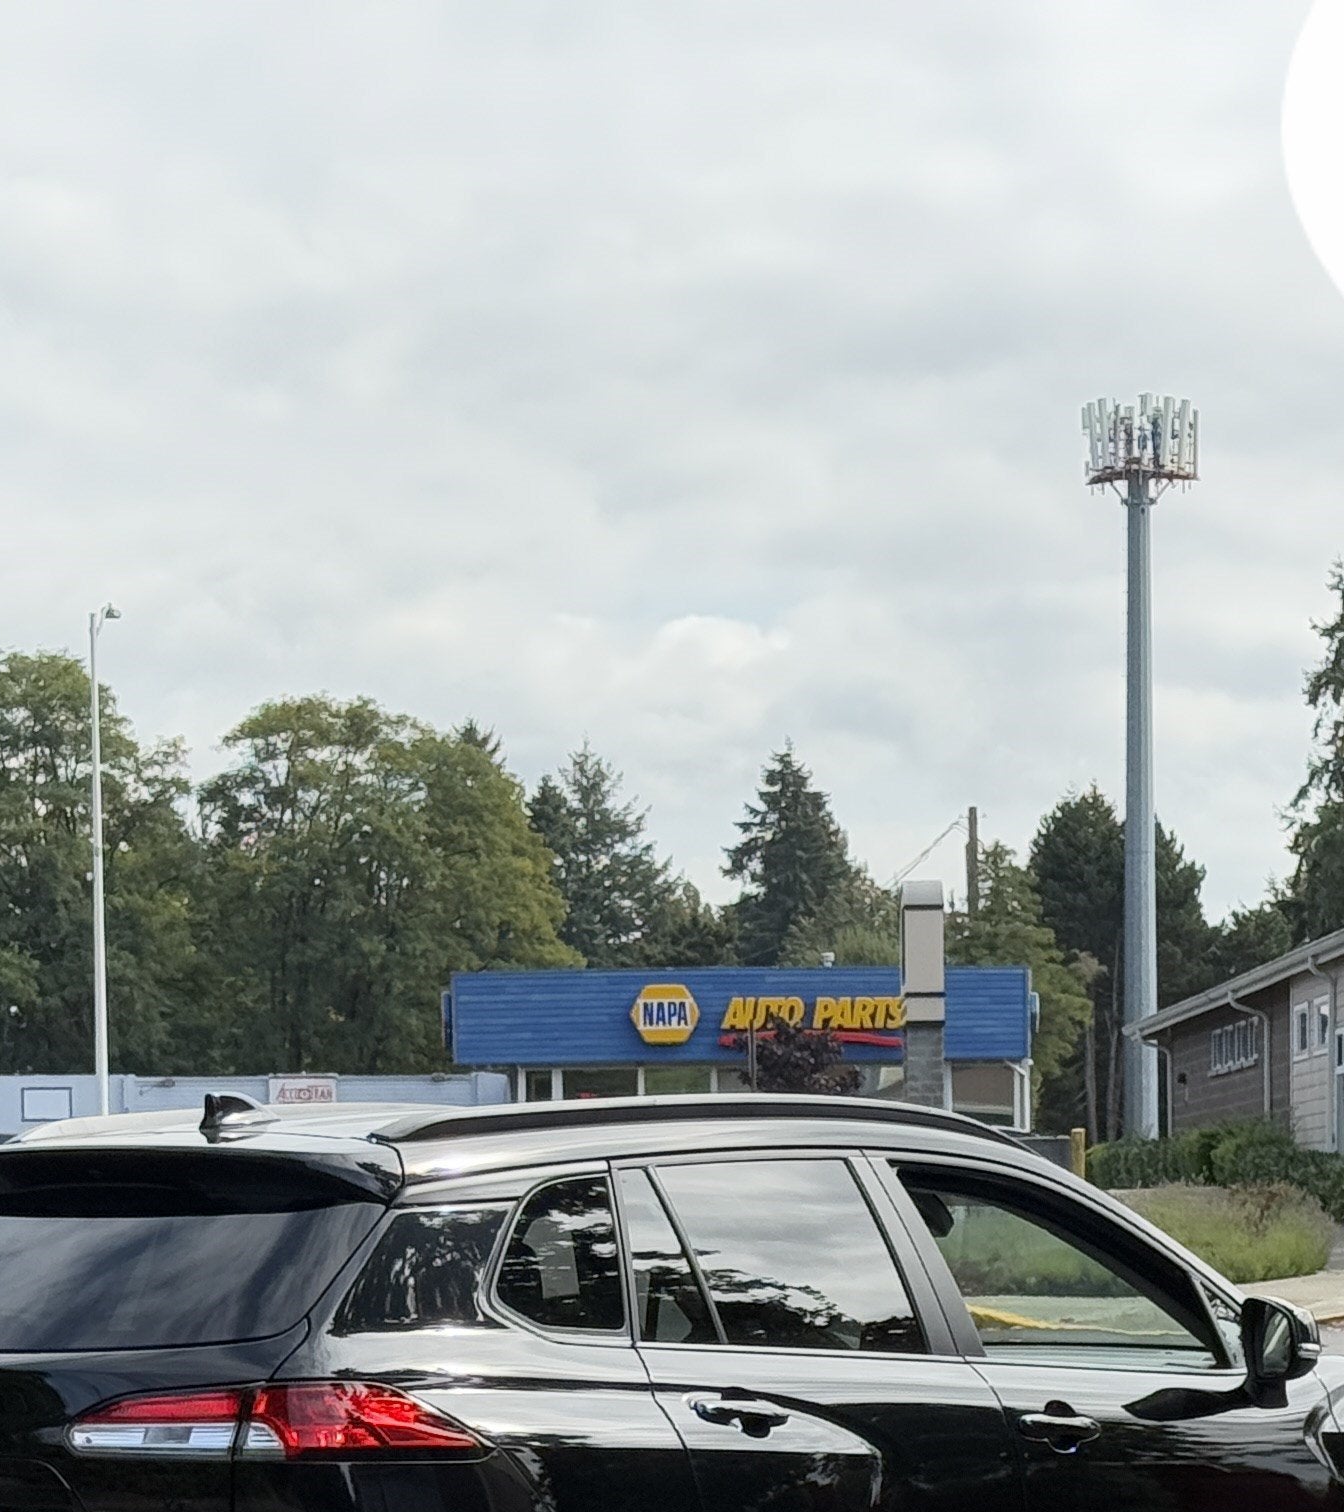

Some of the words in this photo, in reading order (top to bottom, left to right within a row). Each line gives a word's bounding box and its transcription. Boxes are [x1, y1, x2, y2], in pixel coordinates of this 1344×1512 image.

[642, 1000, 689, 1027] NAPA
[720, 996, 806, 1031] AUTO
[812, 996, 907, 1030] PARTS
